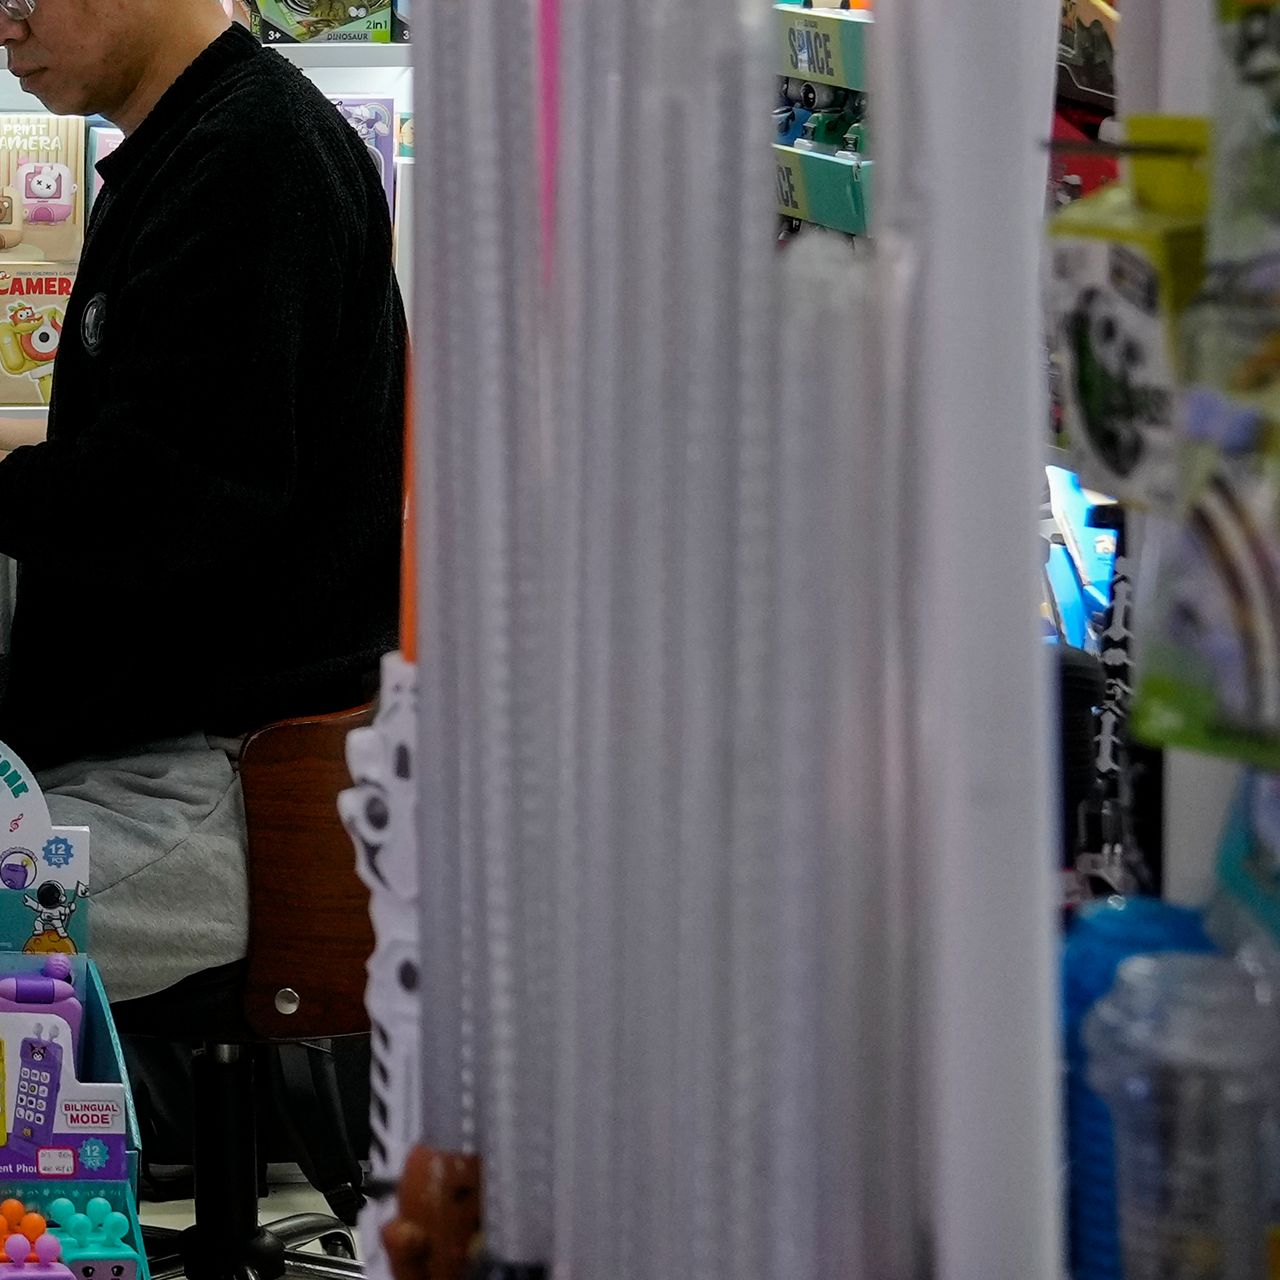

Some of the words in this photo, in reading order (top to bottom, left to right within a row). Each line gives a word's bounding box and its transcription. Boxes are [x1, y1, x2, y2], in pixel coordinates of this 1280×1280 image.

[366, 20, 388, 30] 2in1
[268, 31, 281, 40] 3+
[789, 27, 835, 77] SACE
[2, 123, 47, 135] PRINT
[49, 843, 66, 854] 12
[63, 1103, 118, 1113] BILINGUAL
[70, 1113, 111, 1125] MODE
